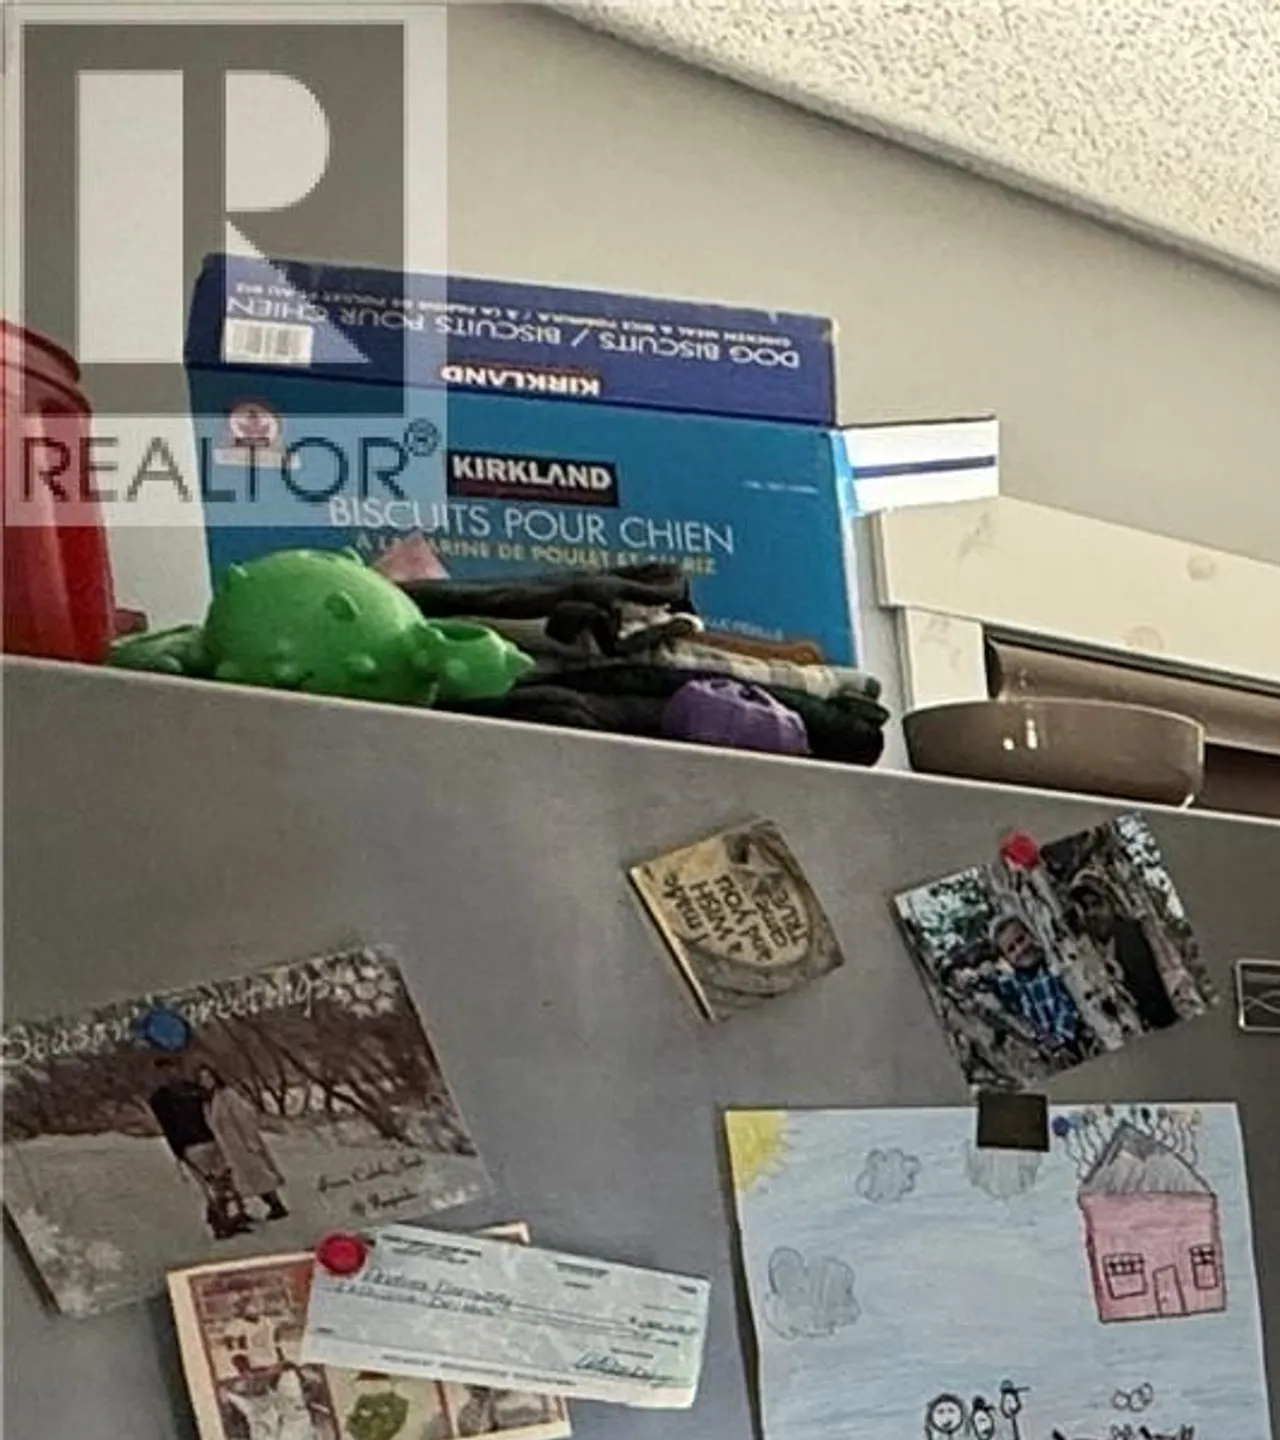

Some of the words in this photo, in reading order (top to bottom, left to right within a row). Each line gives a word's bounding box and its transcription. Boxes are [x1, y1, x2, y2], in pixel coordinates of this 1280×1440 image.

[227, 295, 327, 323] CHIEN
[340, 304, 424, 331] POUR
[434, 314, 561, 345] BISCUITS
[598, 329, 720, 362] BISCUITS
[729, 345, 800, 369] DOG
[440, 364, 601, 397] KIRKLAND
[452, 455, 613, 491] KIRKLAND
[328, 496, 492, 538] BISCUITS
[503, 506, 607, 544] POUR
[618, 515, 734, 556] CHIEN
